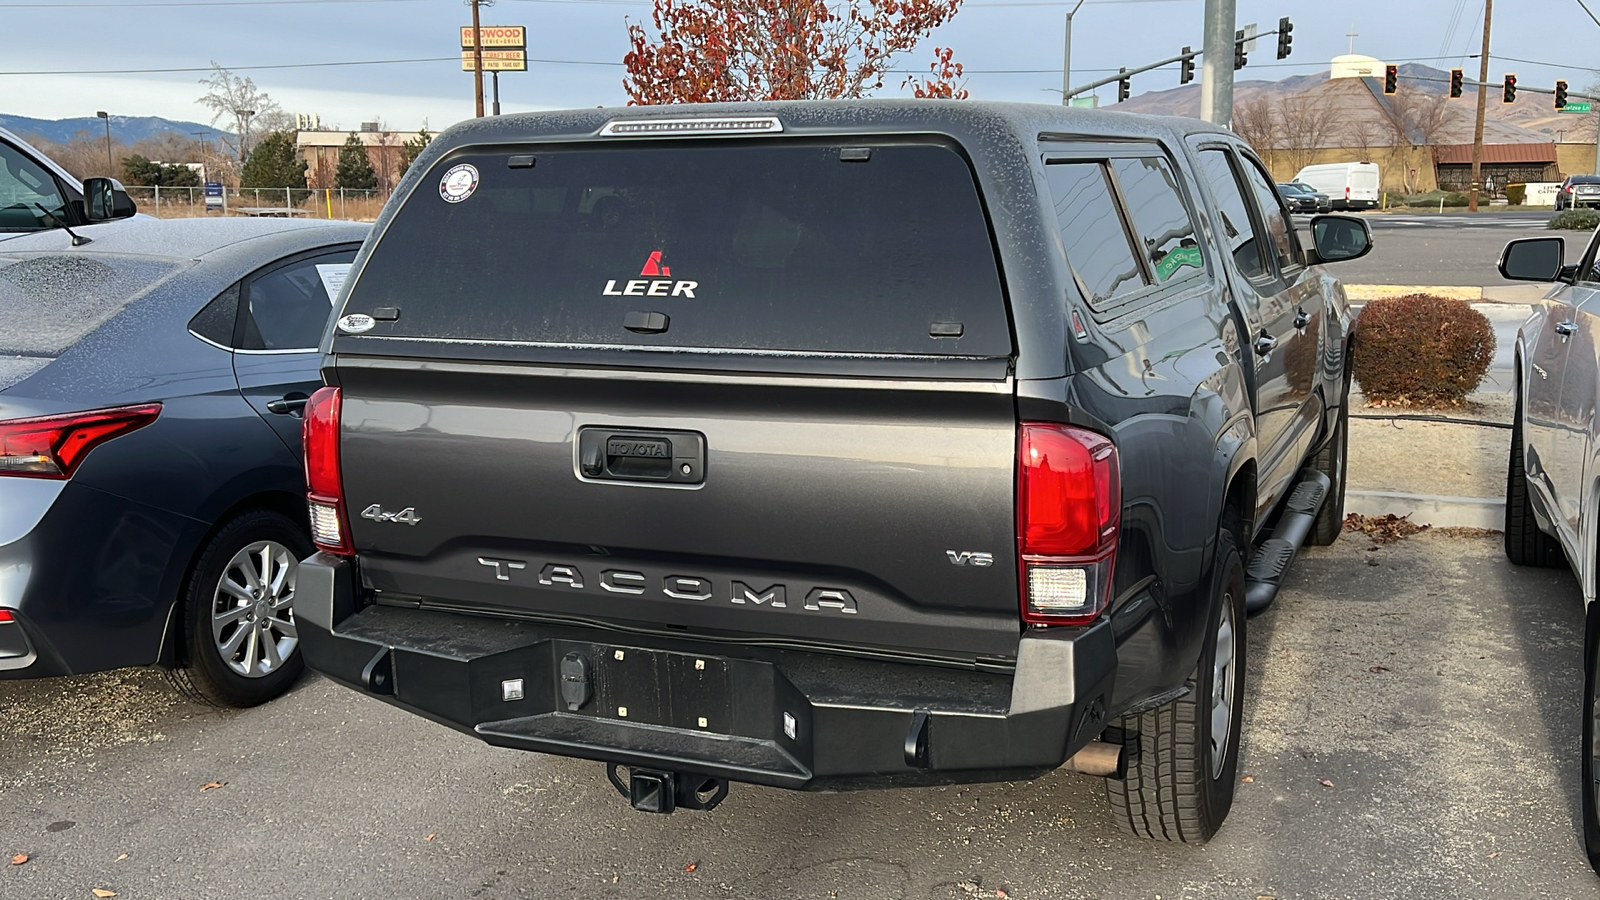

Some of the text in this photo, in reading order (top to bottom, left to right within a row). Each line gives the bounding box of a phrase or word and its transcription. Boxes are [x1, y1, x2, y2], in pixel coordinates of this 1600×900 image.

[602, 280, 699, 298] LEER
[610, 443, 666, 457] TOYOTA
[946, 549, 994, 567] V6
[477, 556, 858, 615] TACOMA
